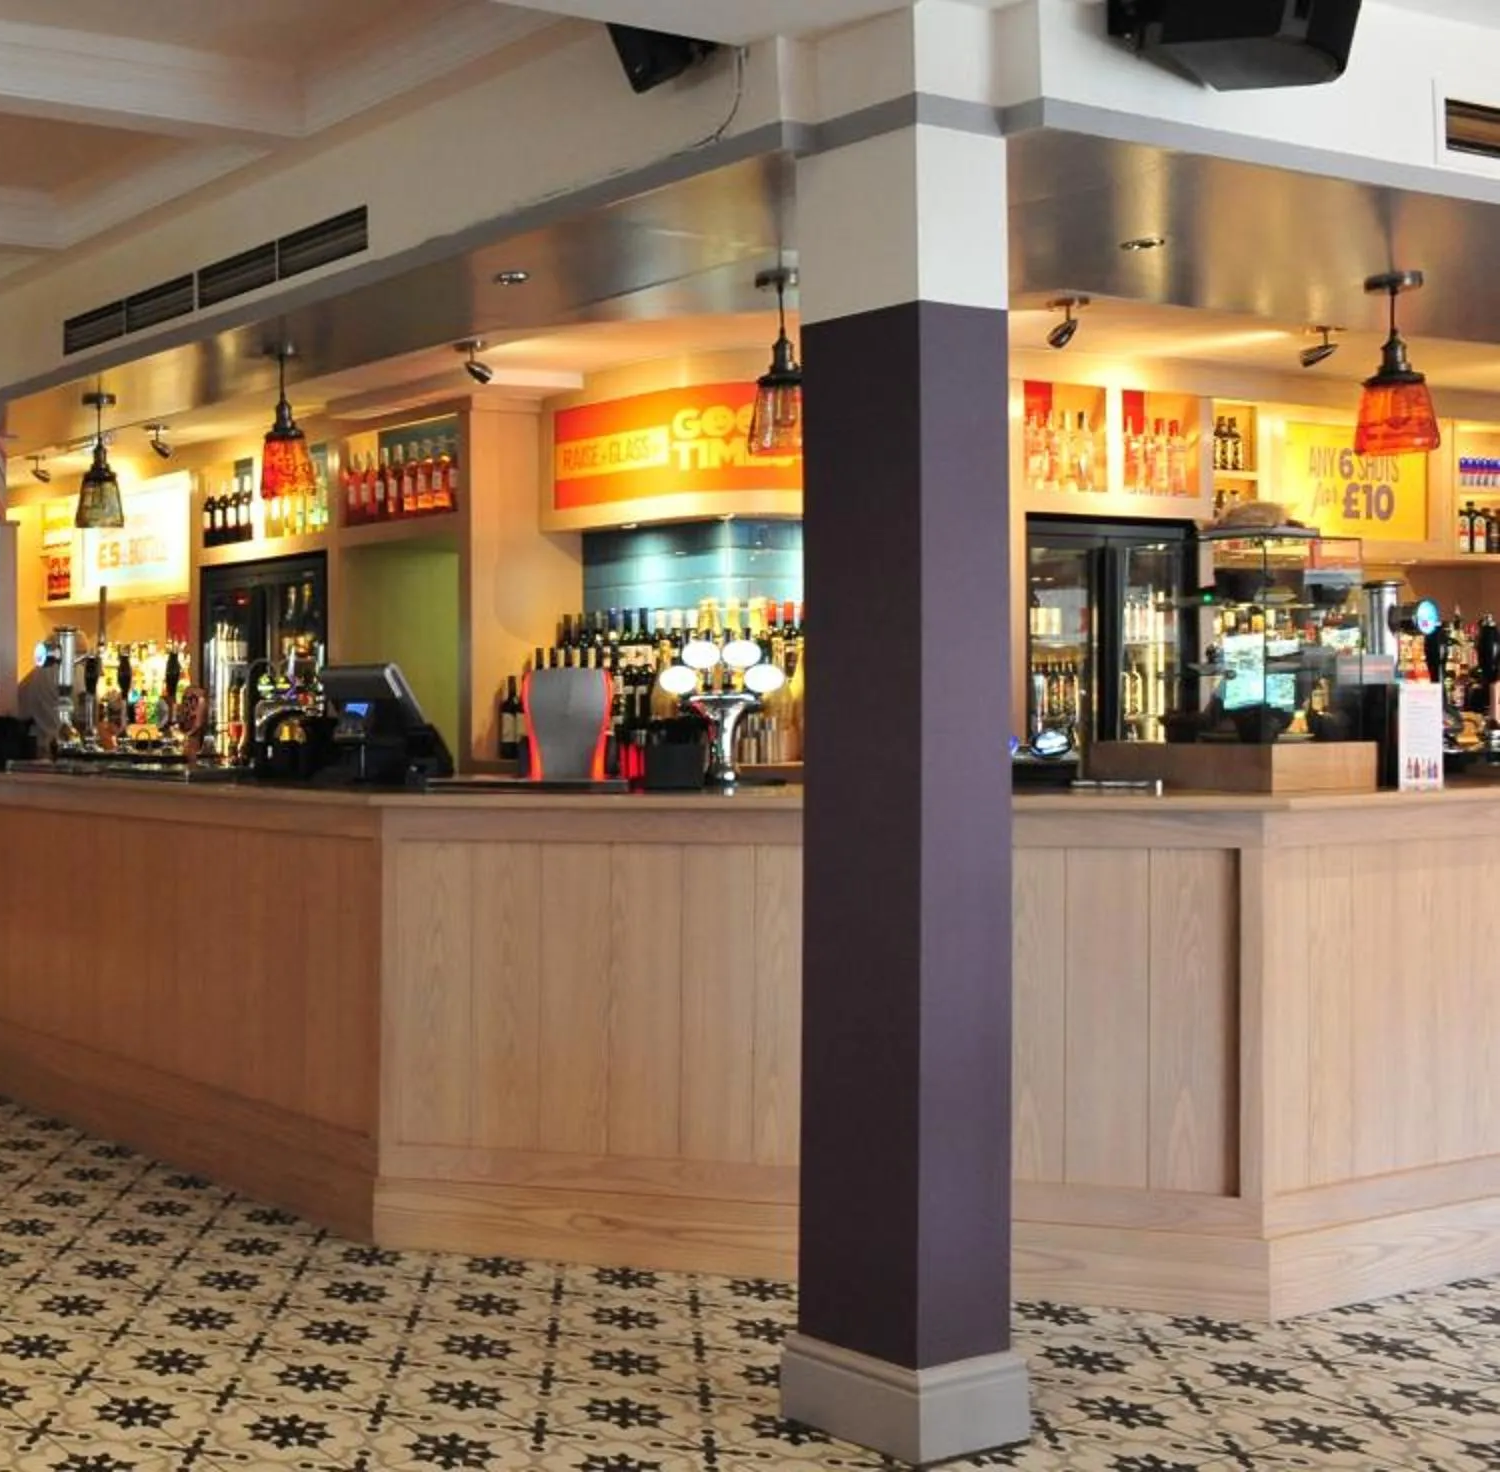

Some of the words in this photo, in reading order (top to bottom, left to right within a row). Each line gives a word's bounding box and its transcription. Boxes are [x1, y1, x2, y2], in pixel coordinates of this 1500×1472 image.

[671, 403, 757, 440] GOO
[1309, 446, 1336, 479] ANY
[1338, 447, 1354, 480] 6
[1357, 453, 1400, 482] SHOTS
[1343, 482, 1395, 521] £10
